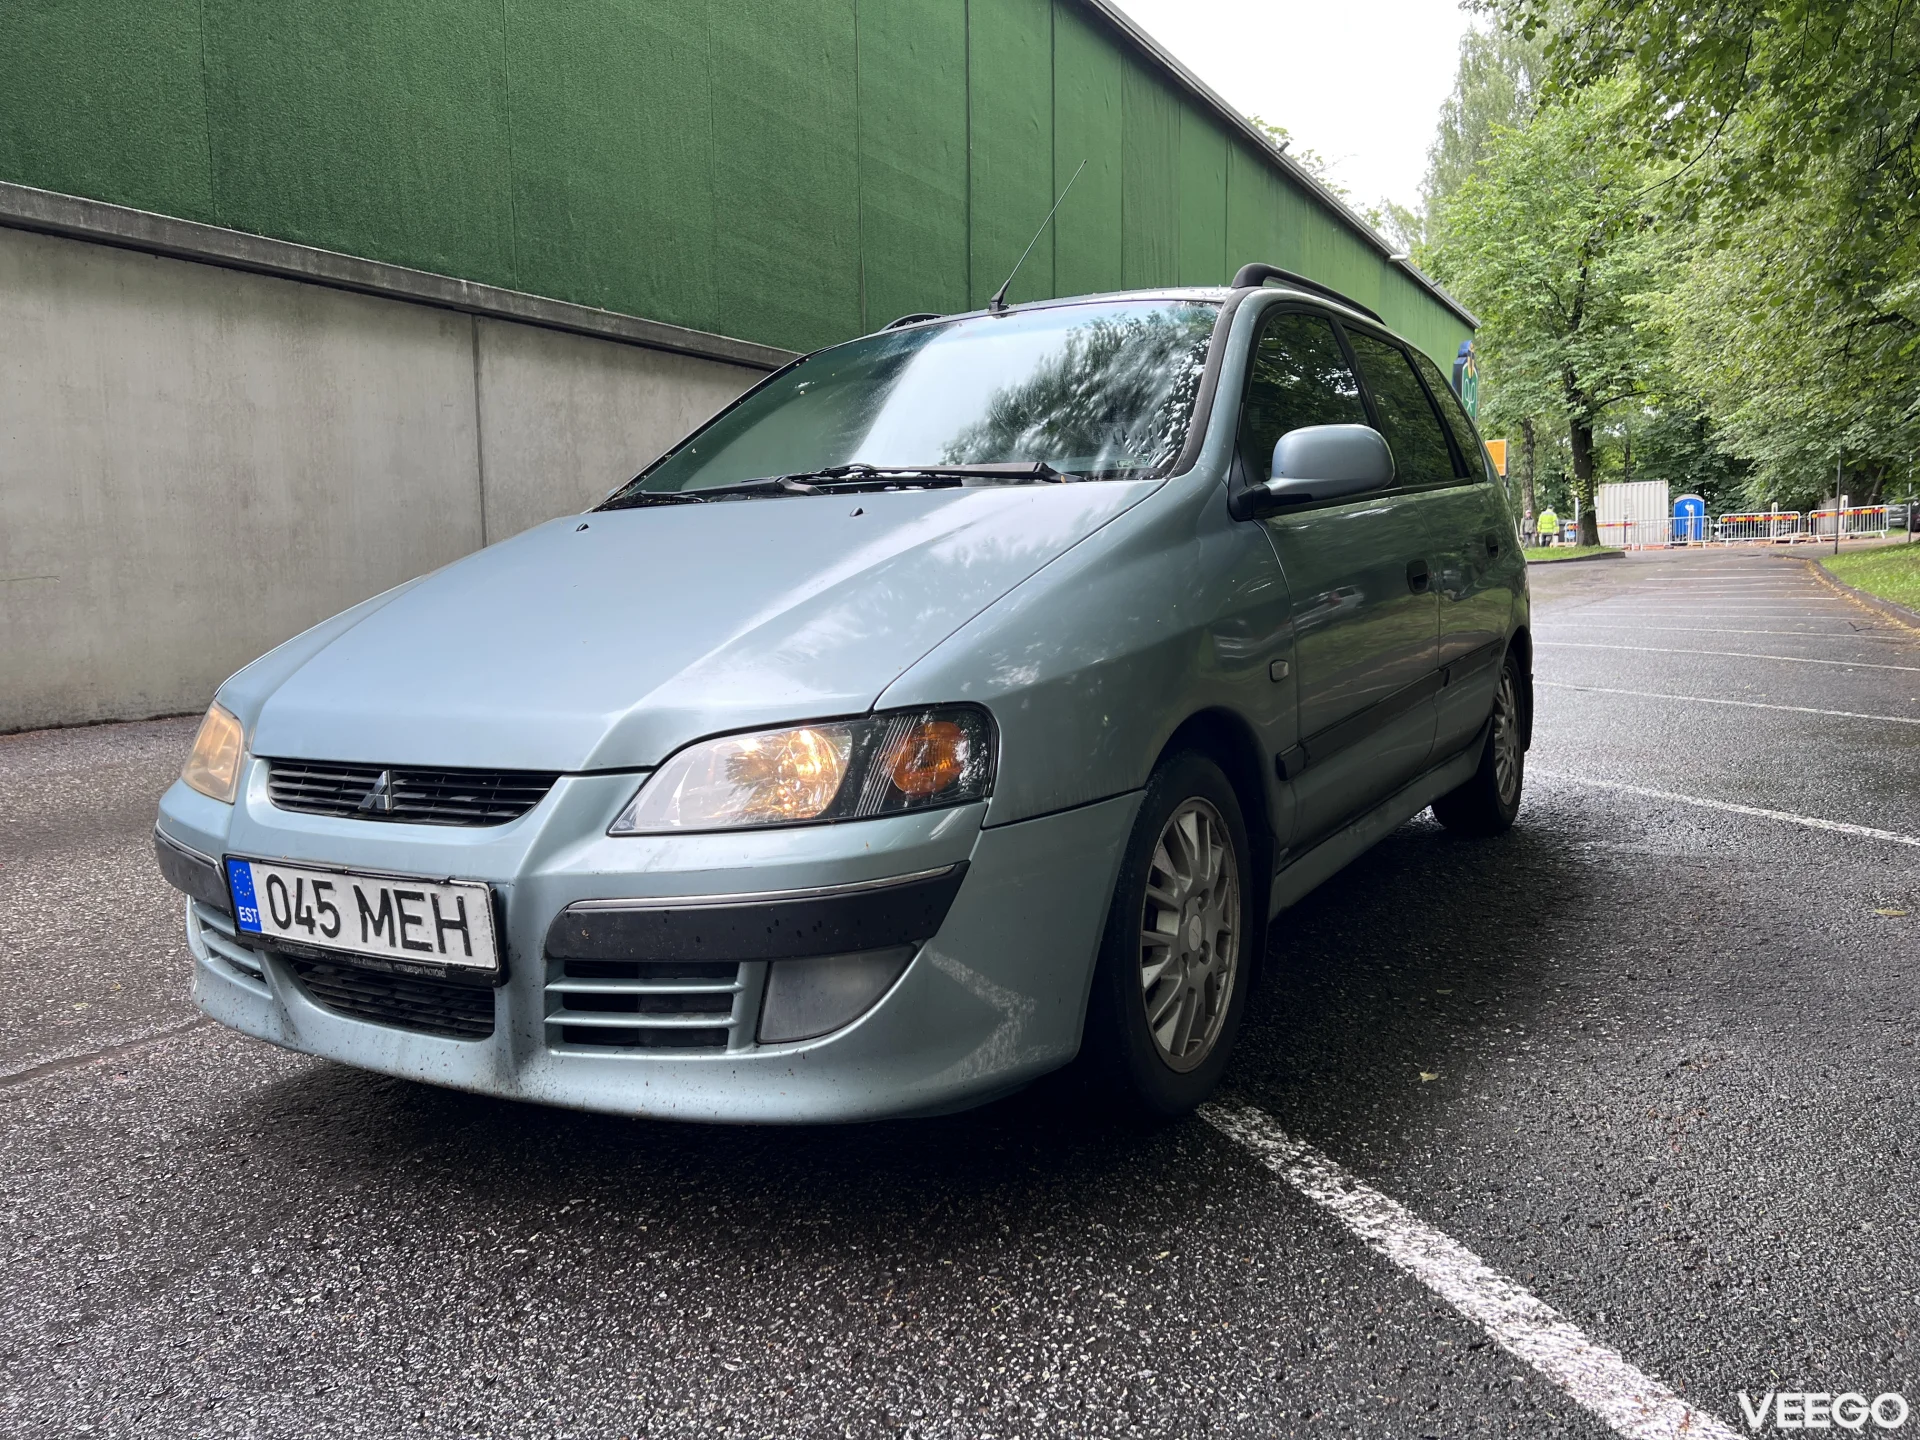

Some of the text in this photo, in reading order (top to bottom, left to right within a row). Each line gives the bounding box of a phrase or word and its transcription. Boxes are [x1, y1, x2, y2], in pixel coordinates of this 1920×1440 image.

[238, 906, 259, 923] EST
[266, 873, 473, 957] 045 MEH
